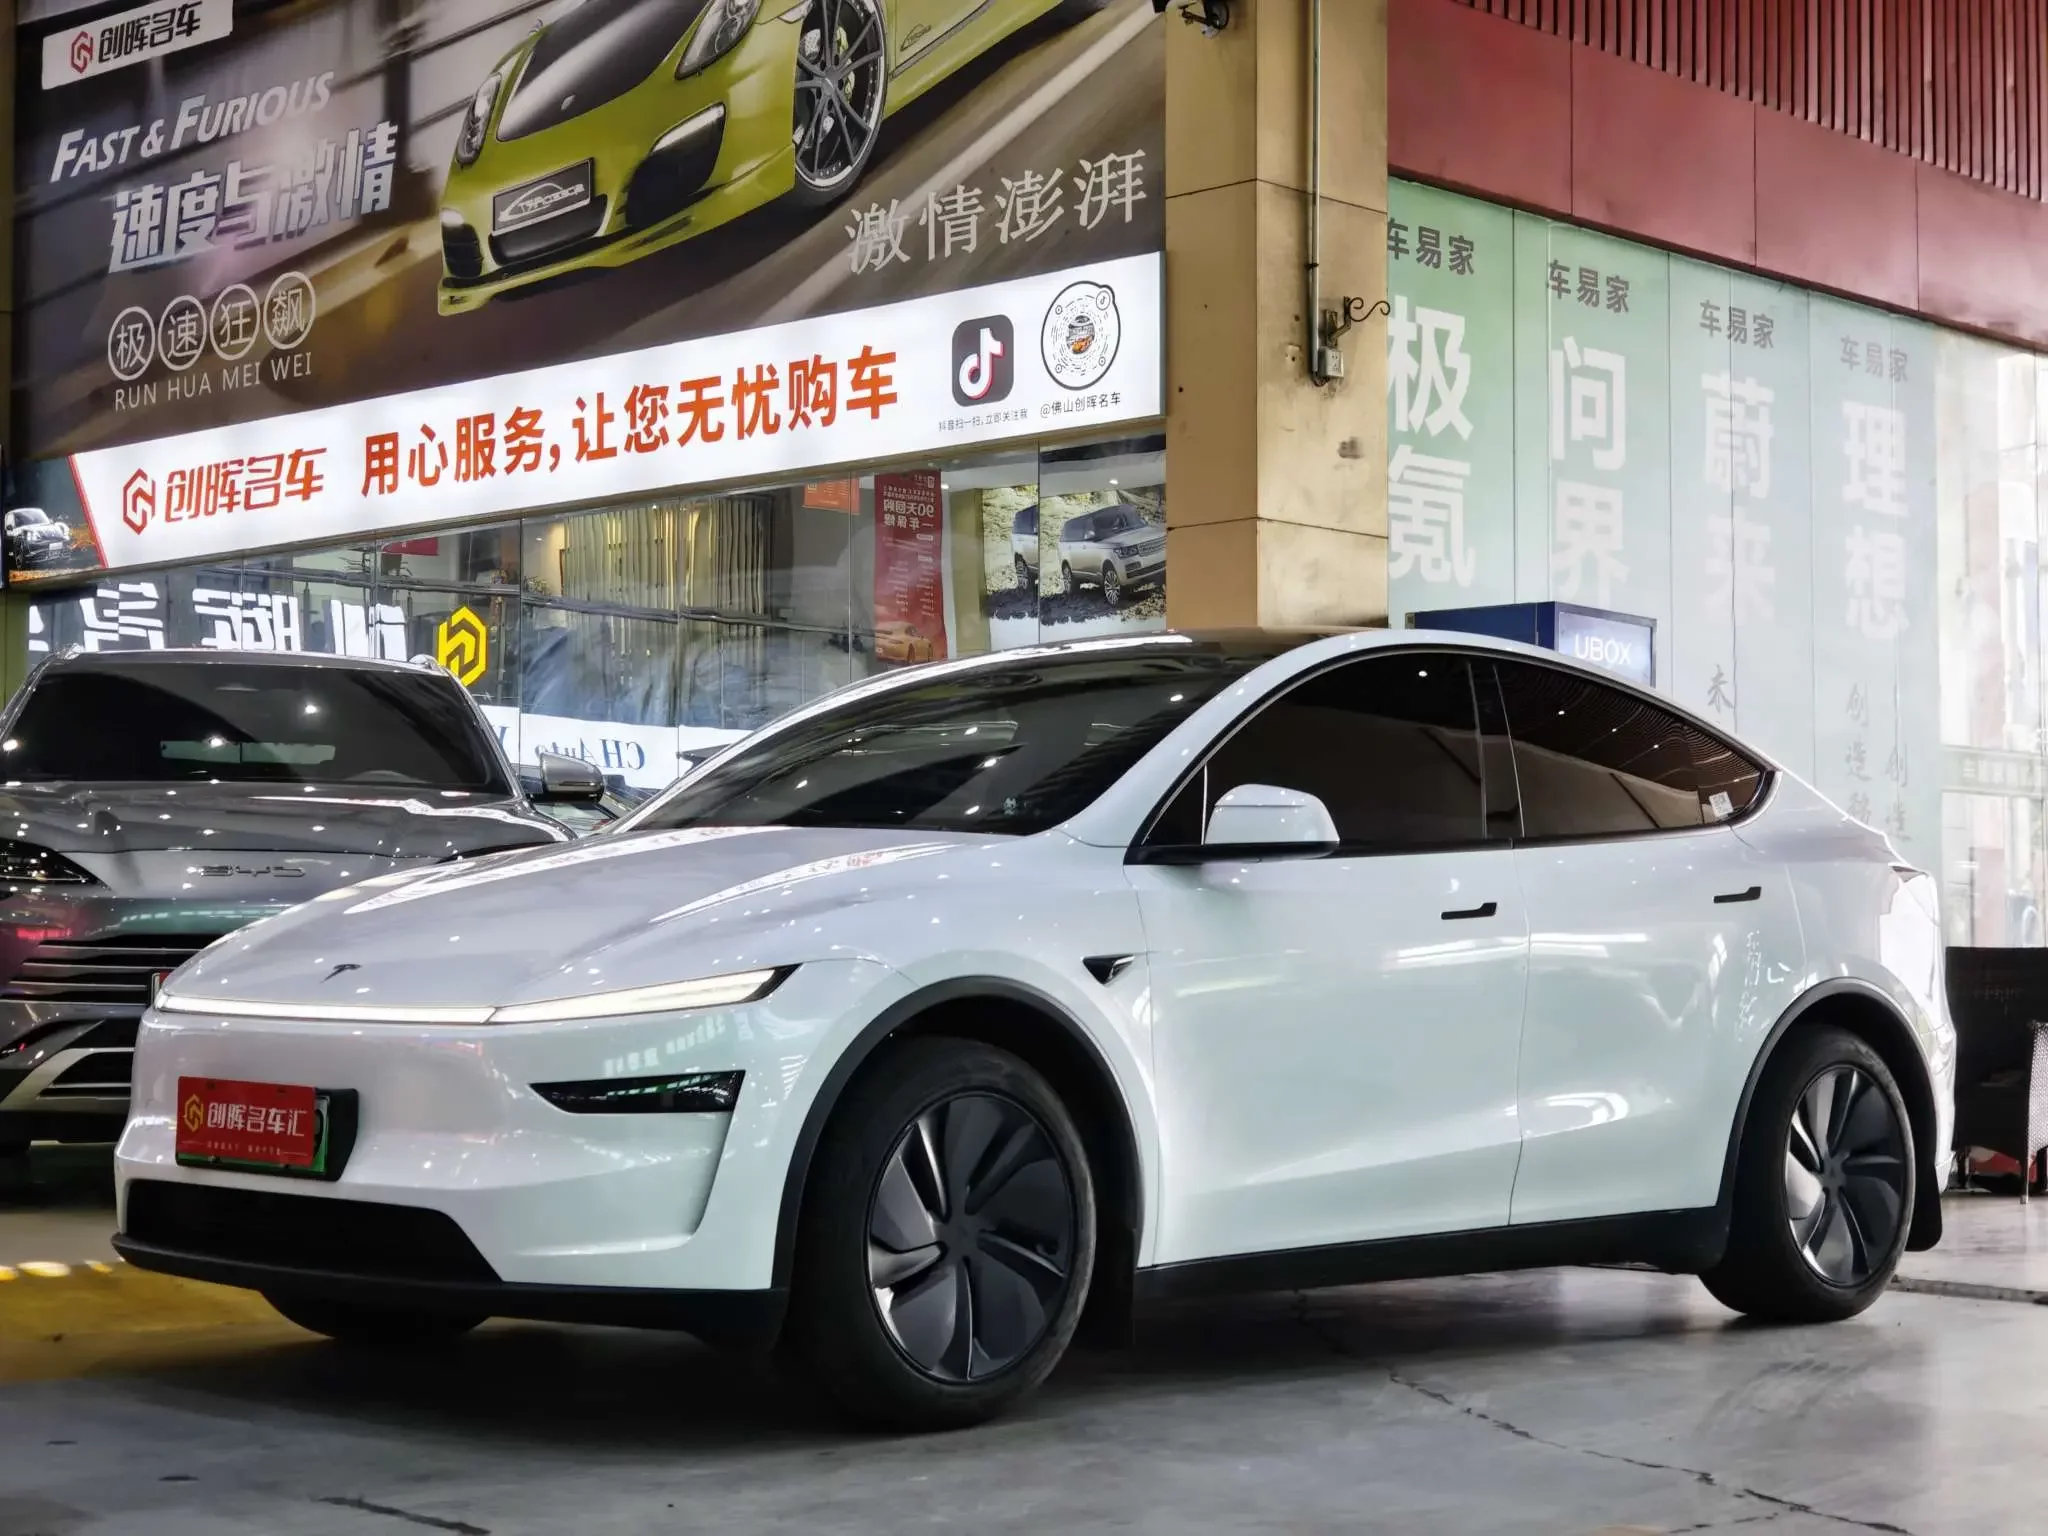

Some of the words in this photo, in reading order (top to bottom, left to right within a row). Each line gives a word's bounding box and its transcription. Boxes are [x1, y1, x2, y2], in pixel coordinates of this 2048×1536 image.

[50, 129, 129, 183] FAST
[140, 119, 165, 158] &
[171, 71, 335, 149] FURIOUS
[108, 121, 399, 274] 速度与激情
[845, 149, 1147, 275] 激情澎湃
[1386, 219, 1475, 276] 车易家
[1546, 259, 1630, 314] 车易家
[1700, 299, 1775, 350] 车易家
[115, 386, 156, 413] RUN
[168, 377, 212, 400] HUA
[222, 362, 261, 391] MEI
[271, 352, 312, 381] WEI
[1841, 334, 1909, 382] 车易家
[1387, 295, 1476, 588] 极氪
[1550, 335, 1630, 600] 问界
[165, 447, 326, 524] 创晖名车
[1700, 370, 1776, 628] 蔚来
[1841, 400, 1911, 640] 理想
[1575, 636, 1632, 666] UBOX
[207, 1101, 308, 1137] 创晖名车汇
